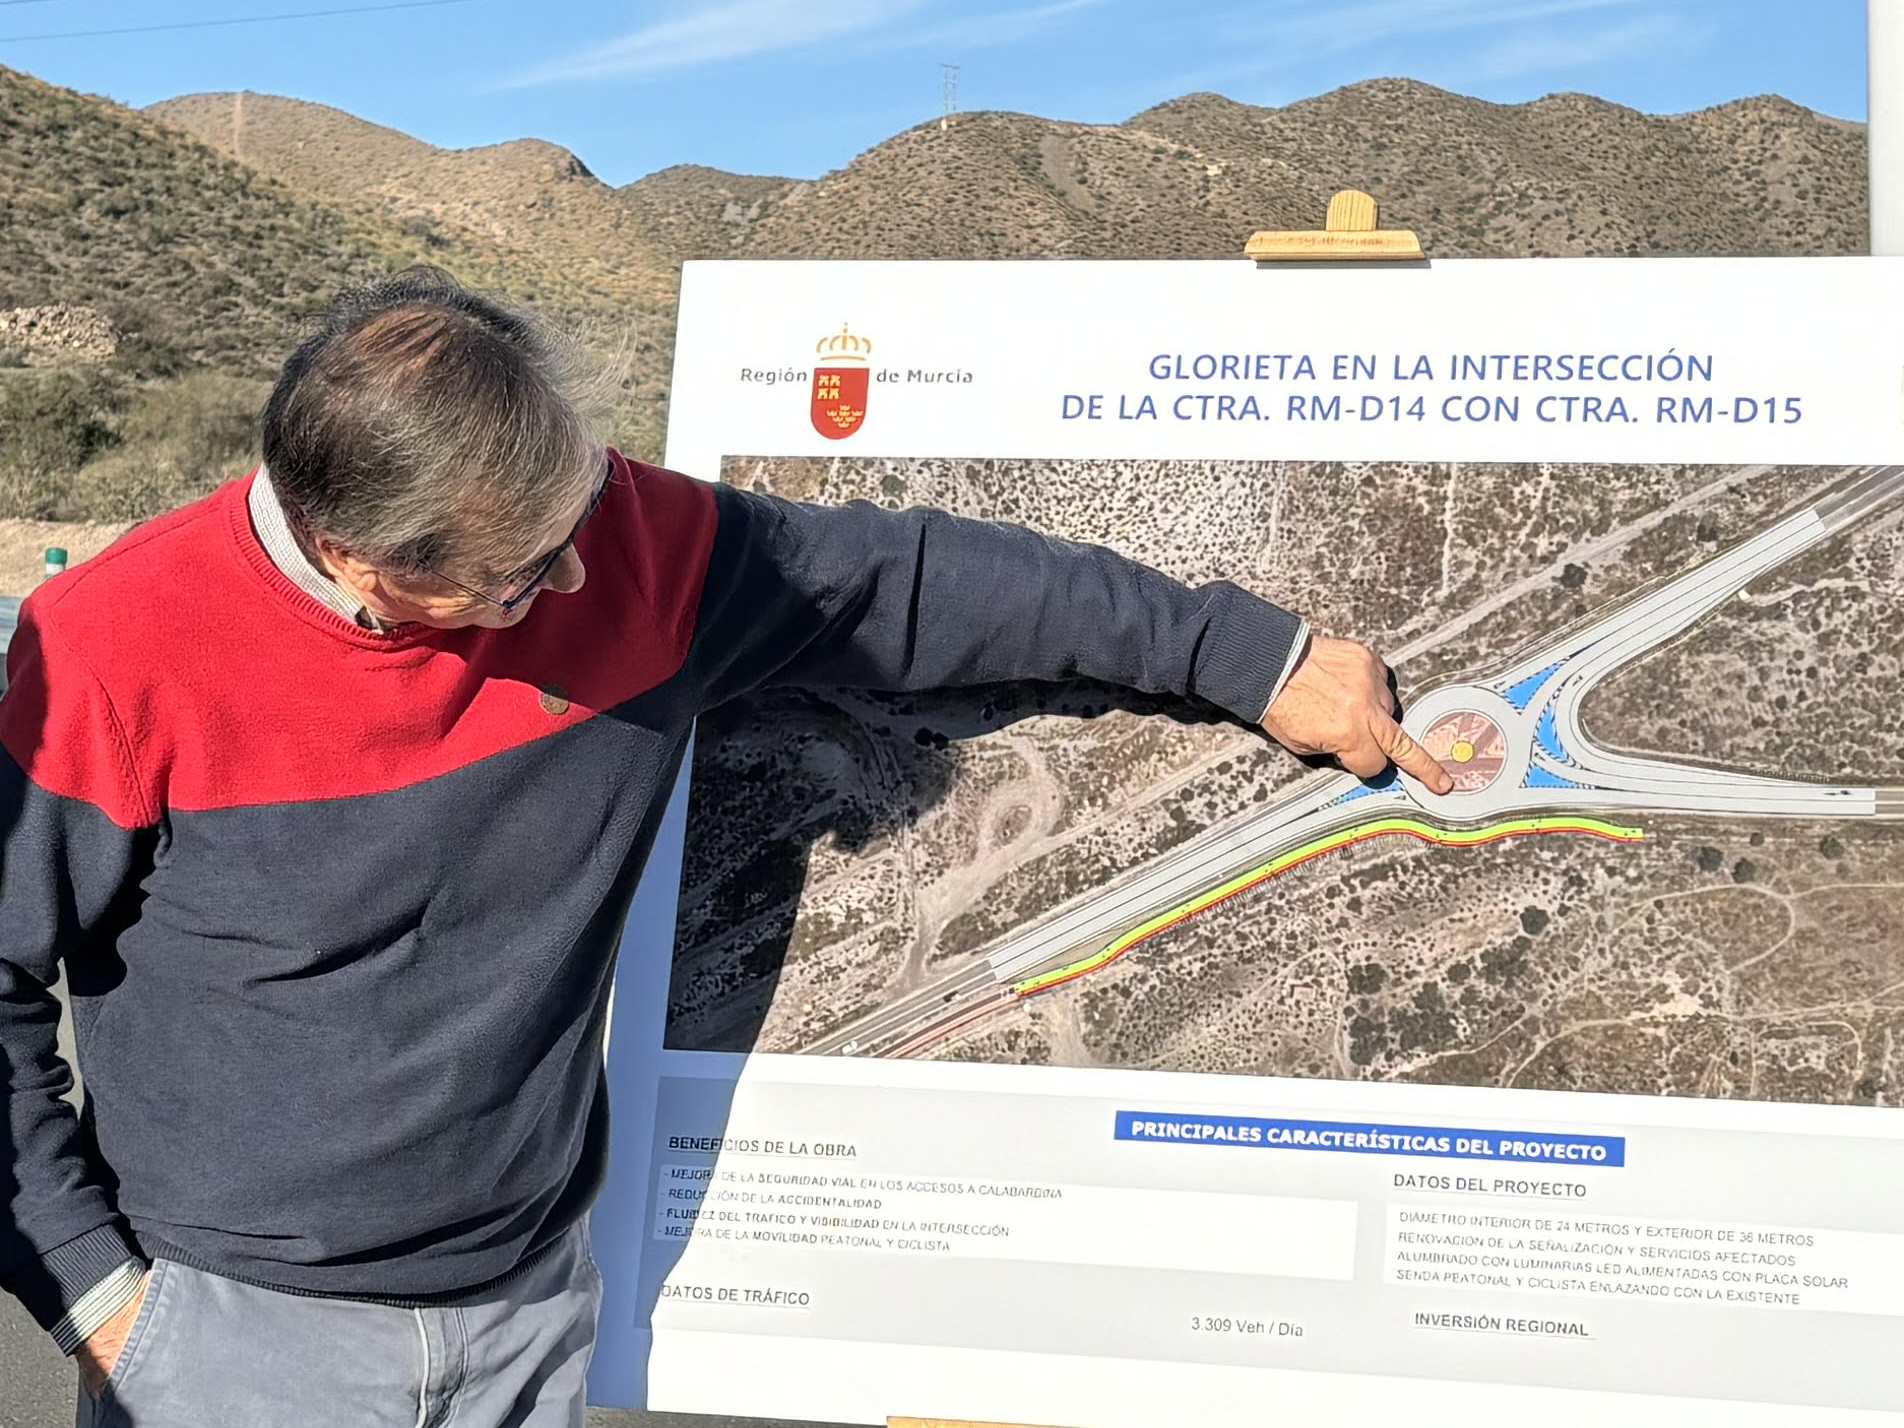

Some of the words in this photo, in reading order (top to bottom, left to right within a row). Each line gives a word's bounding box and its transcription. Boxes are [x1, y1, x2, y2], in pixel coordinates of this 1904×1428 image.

[740, 367, 808, 385] Región
[876, 369, 900, 383] de
[906, 369, 974, 384] Murcia
[1149, 354, 1316, 381] GLORIETA
[1332, 354, 1376, 381] EN
[1393, 354, 1434, 381] LA
[1450, 348, 1713, 382] INTERSECCIÓN
[1061, 394, 1104, 420] DE
[1118, 394, 1158, 420] LA
[1173, 394, 1270, 421] CTRA.
[1287, 395, 1427, 422] RM-D14
[1441, 395, 1520, 423] CON
[1535, 395, 1639, 424] CTRA.
[1656, 396, 1803, 424] RM-D15
[764, 1140, 784, 1153] DE
[789, 1141, 809, 1155] LA
[813, 1143, 857, 1157] OBRA
[1131, 1120, 1262, 1142] PRINCIPALES
[1266, 1127, 1450, 1153] CARACTERÍSTICAS
[1455, 1138, 1494, 1155] DEL
[1499, 1140, 1607, 1161] PROYECTO
[740, 1173, 754, 1184] LA
[758, 1173, 828, 1187] SEGURIDAD
[880, 1180, 903, 1191] LOS
[906, 1181, 964, 1194] ACCESOS
[967, 1185, 976, 1195] A
[1393, 1173, 1451, 1190] DATOS
[1455, 1177, 1488, 1192] DEL
[1493, 1179, 1587, 1198] PROYECTO
[741, 1192, 757, 1203] DE
[760, 1193, 775, 1204] LA
[778, 1194, 882, 1209] ACCIDENTALIDAD
[718, 1211, 740, 1222] DEL
[800, 1215, 807, 1226] Y
[901, 1221, 917, 1232] LA
[1535, 1219, 1552, 1231] DE
[1556, 1220, 1570, 1232] 24
[1574, 1222, 1630, 1236] METROS
[1634, 1225, 1642, 1236] Y
[1646, 1226, 1713, 1241] EXTERIOR
[1717, 1230, 1735, 1242] DE
[1758, 1233, 1815, 1247] METROS
[715, 1229, 732, 1240] DE
[735, 1230, 749, 1241] LA
[752, 1231, 818, 1244] MOVILIDAD
[821, 1234, 882, 1249] PEATONAL
[887, 1238, 893, 1249] Y
[897, 1239, 950, 1252] CICLISTA
[1488, 1237, 1504, 1249] DE
[1509, 1239, 1524, 1250] LA
[1628, 1245, 1635, 1256] Y
[1639, 1246, 1711, 1261] SERVICIOS
[1715, 1251, 1796, 1266] AFECTADOS
[1397, 1251, 1478, 1266] ALUMBRADO
[1482, 1255, 1510, 1268] CON
[1596, 1263, 1621, 1275] LED
[1626, 1266, 1718, 1281] ALIMENTADAS
[1722, 1270, 1751, 1283] CON
[1755, 1273, 1798, 1285] PLACA
[1802, 1275, 1848, 1289] SOLAR
[661, 1284, 713, 1300] DATOS
[717, 1288, 738, 1301] DE
[743, 1287, 810, 1306] TRÁFICO
[1397, 1269, 1440, 1282] SENDA
[1444, 1272, 1511, 1287] PEATONAL
[1516, 1277, 1523, 1287] Y
[1528, 1277, 1585, 1291] CICLISTA
[1589, 1281, 1670, 1297] ENLAZANDO
[1674, 1286, 1703, 1299] CON
[1706, 1288, 1723, 1300] LA
[1727, 1290, 1800, 1305] EXISTENTE
[1191, 1316, 1232, 1332] 3.309
[1236, 1319, 1265, 1333] Veh
[1268, 1321, 1275, 1335] /
[1278, 1322, 1304, 1337] Día
[1415, 1312, 1501, 1330] INVERSIÓN
[1506, 1318, 1589, 1336] REGIONAL
